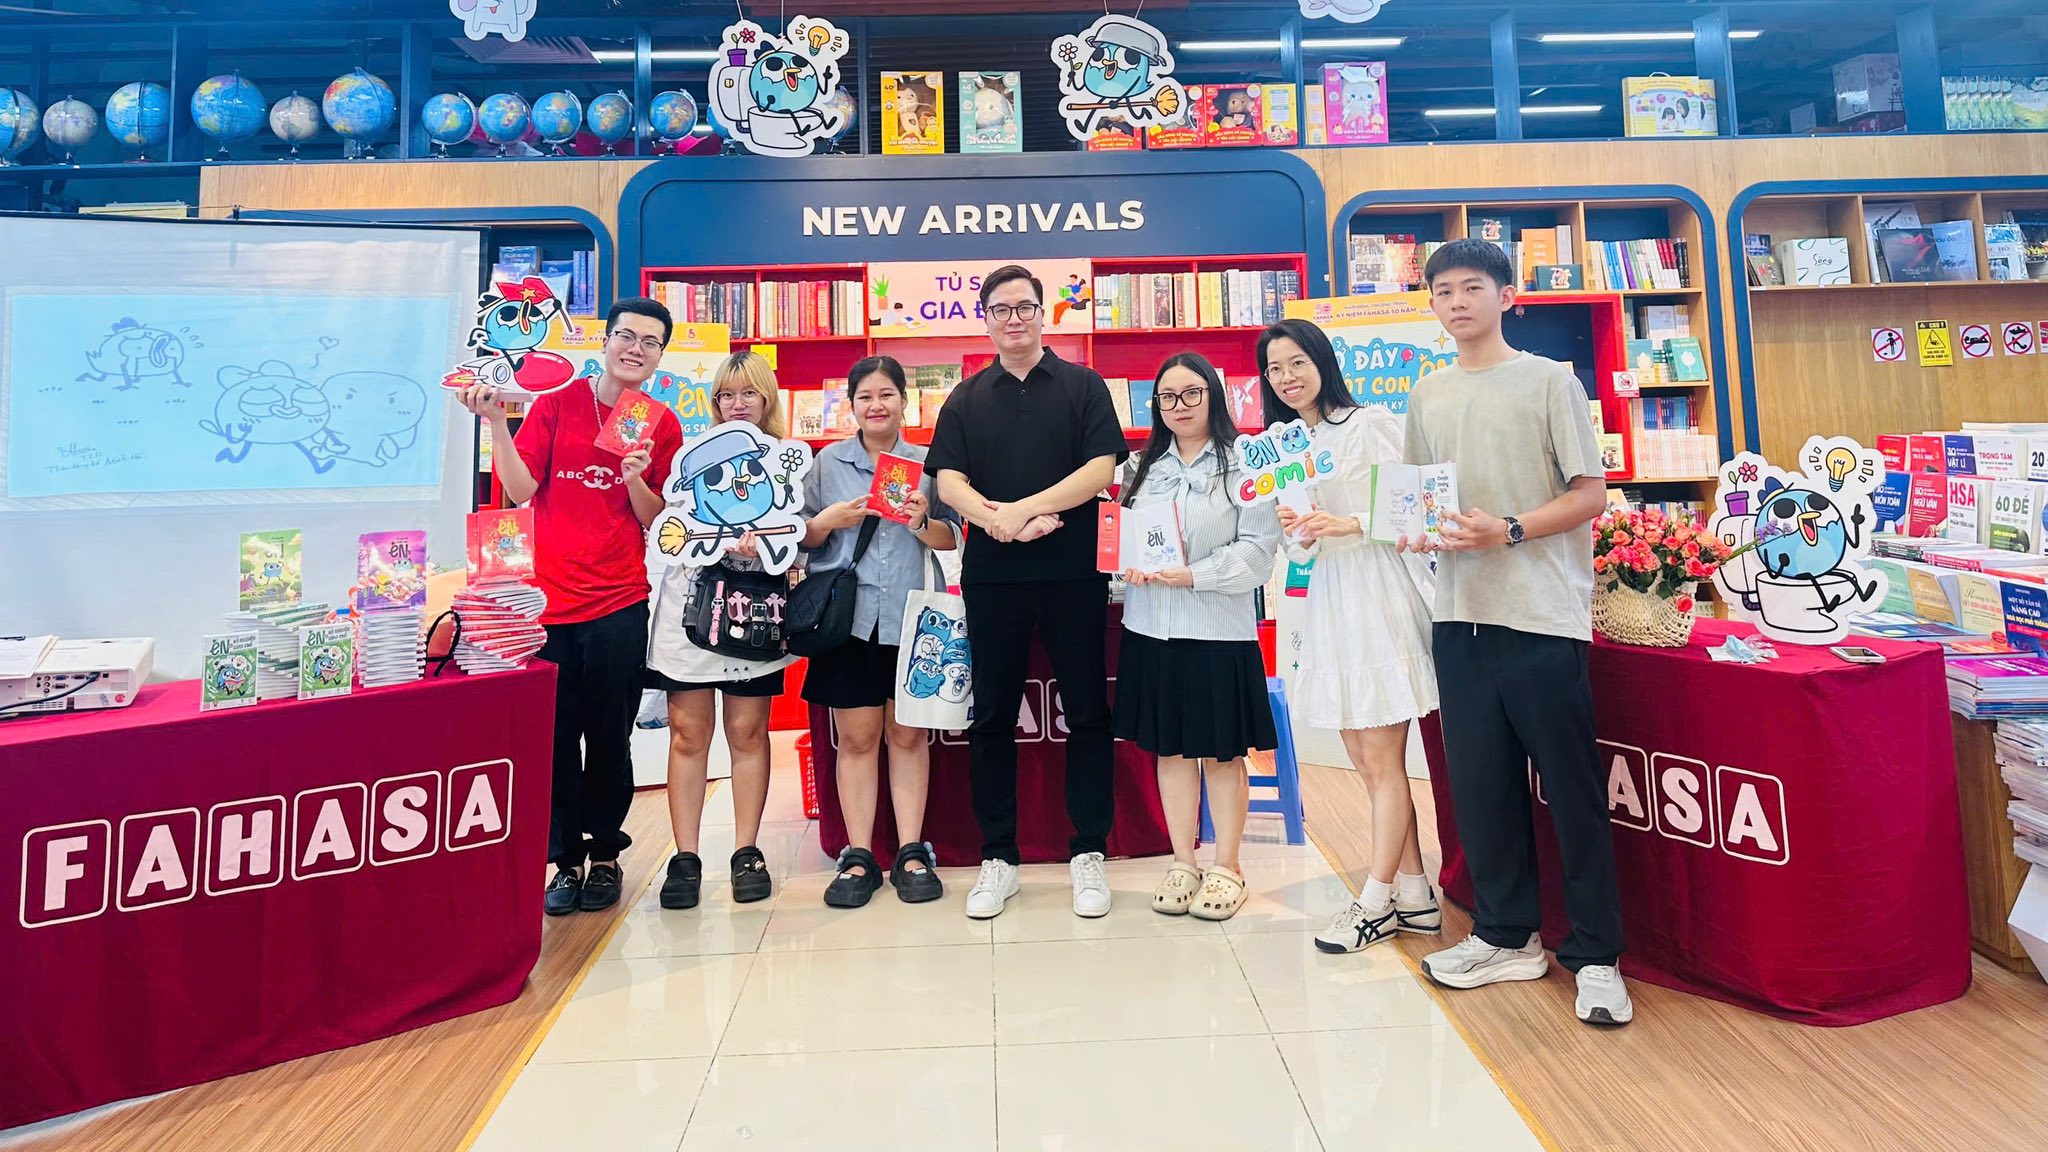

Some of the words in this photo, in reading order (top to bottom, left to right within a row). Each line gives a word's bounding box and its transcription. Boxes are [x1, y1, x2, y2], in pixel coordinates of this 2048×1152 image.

[803, 206, 906, 237] NEW
[918, 200, 1145, 236] ARRIVALS
[935, 271, 962, 291] TỦ
[920, 301, 966, 320] GIA
[1363, 309, 1391, 317] FAHASA
[1354, 343, 1399, 371] ĐÂY
[1345, 373, 1366, 396] ỘT
[1371, 375, 1411, 396] CON
[2031, 451, 2045, 468] 20
[556, 470, 585, 480] ABC
[1240, 451, 1334, 501] comic
[1949, 481, 1975, 507] HSA
[1995, 496, 2010, 512] 60
[2028, 608, 2041, 618] CAO
[1608, 754, 1779, 852] ASA
[44, 773, 503, 912] FAHASA
